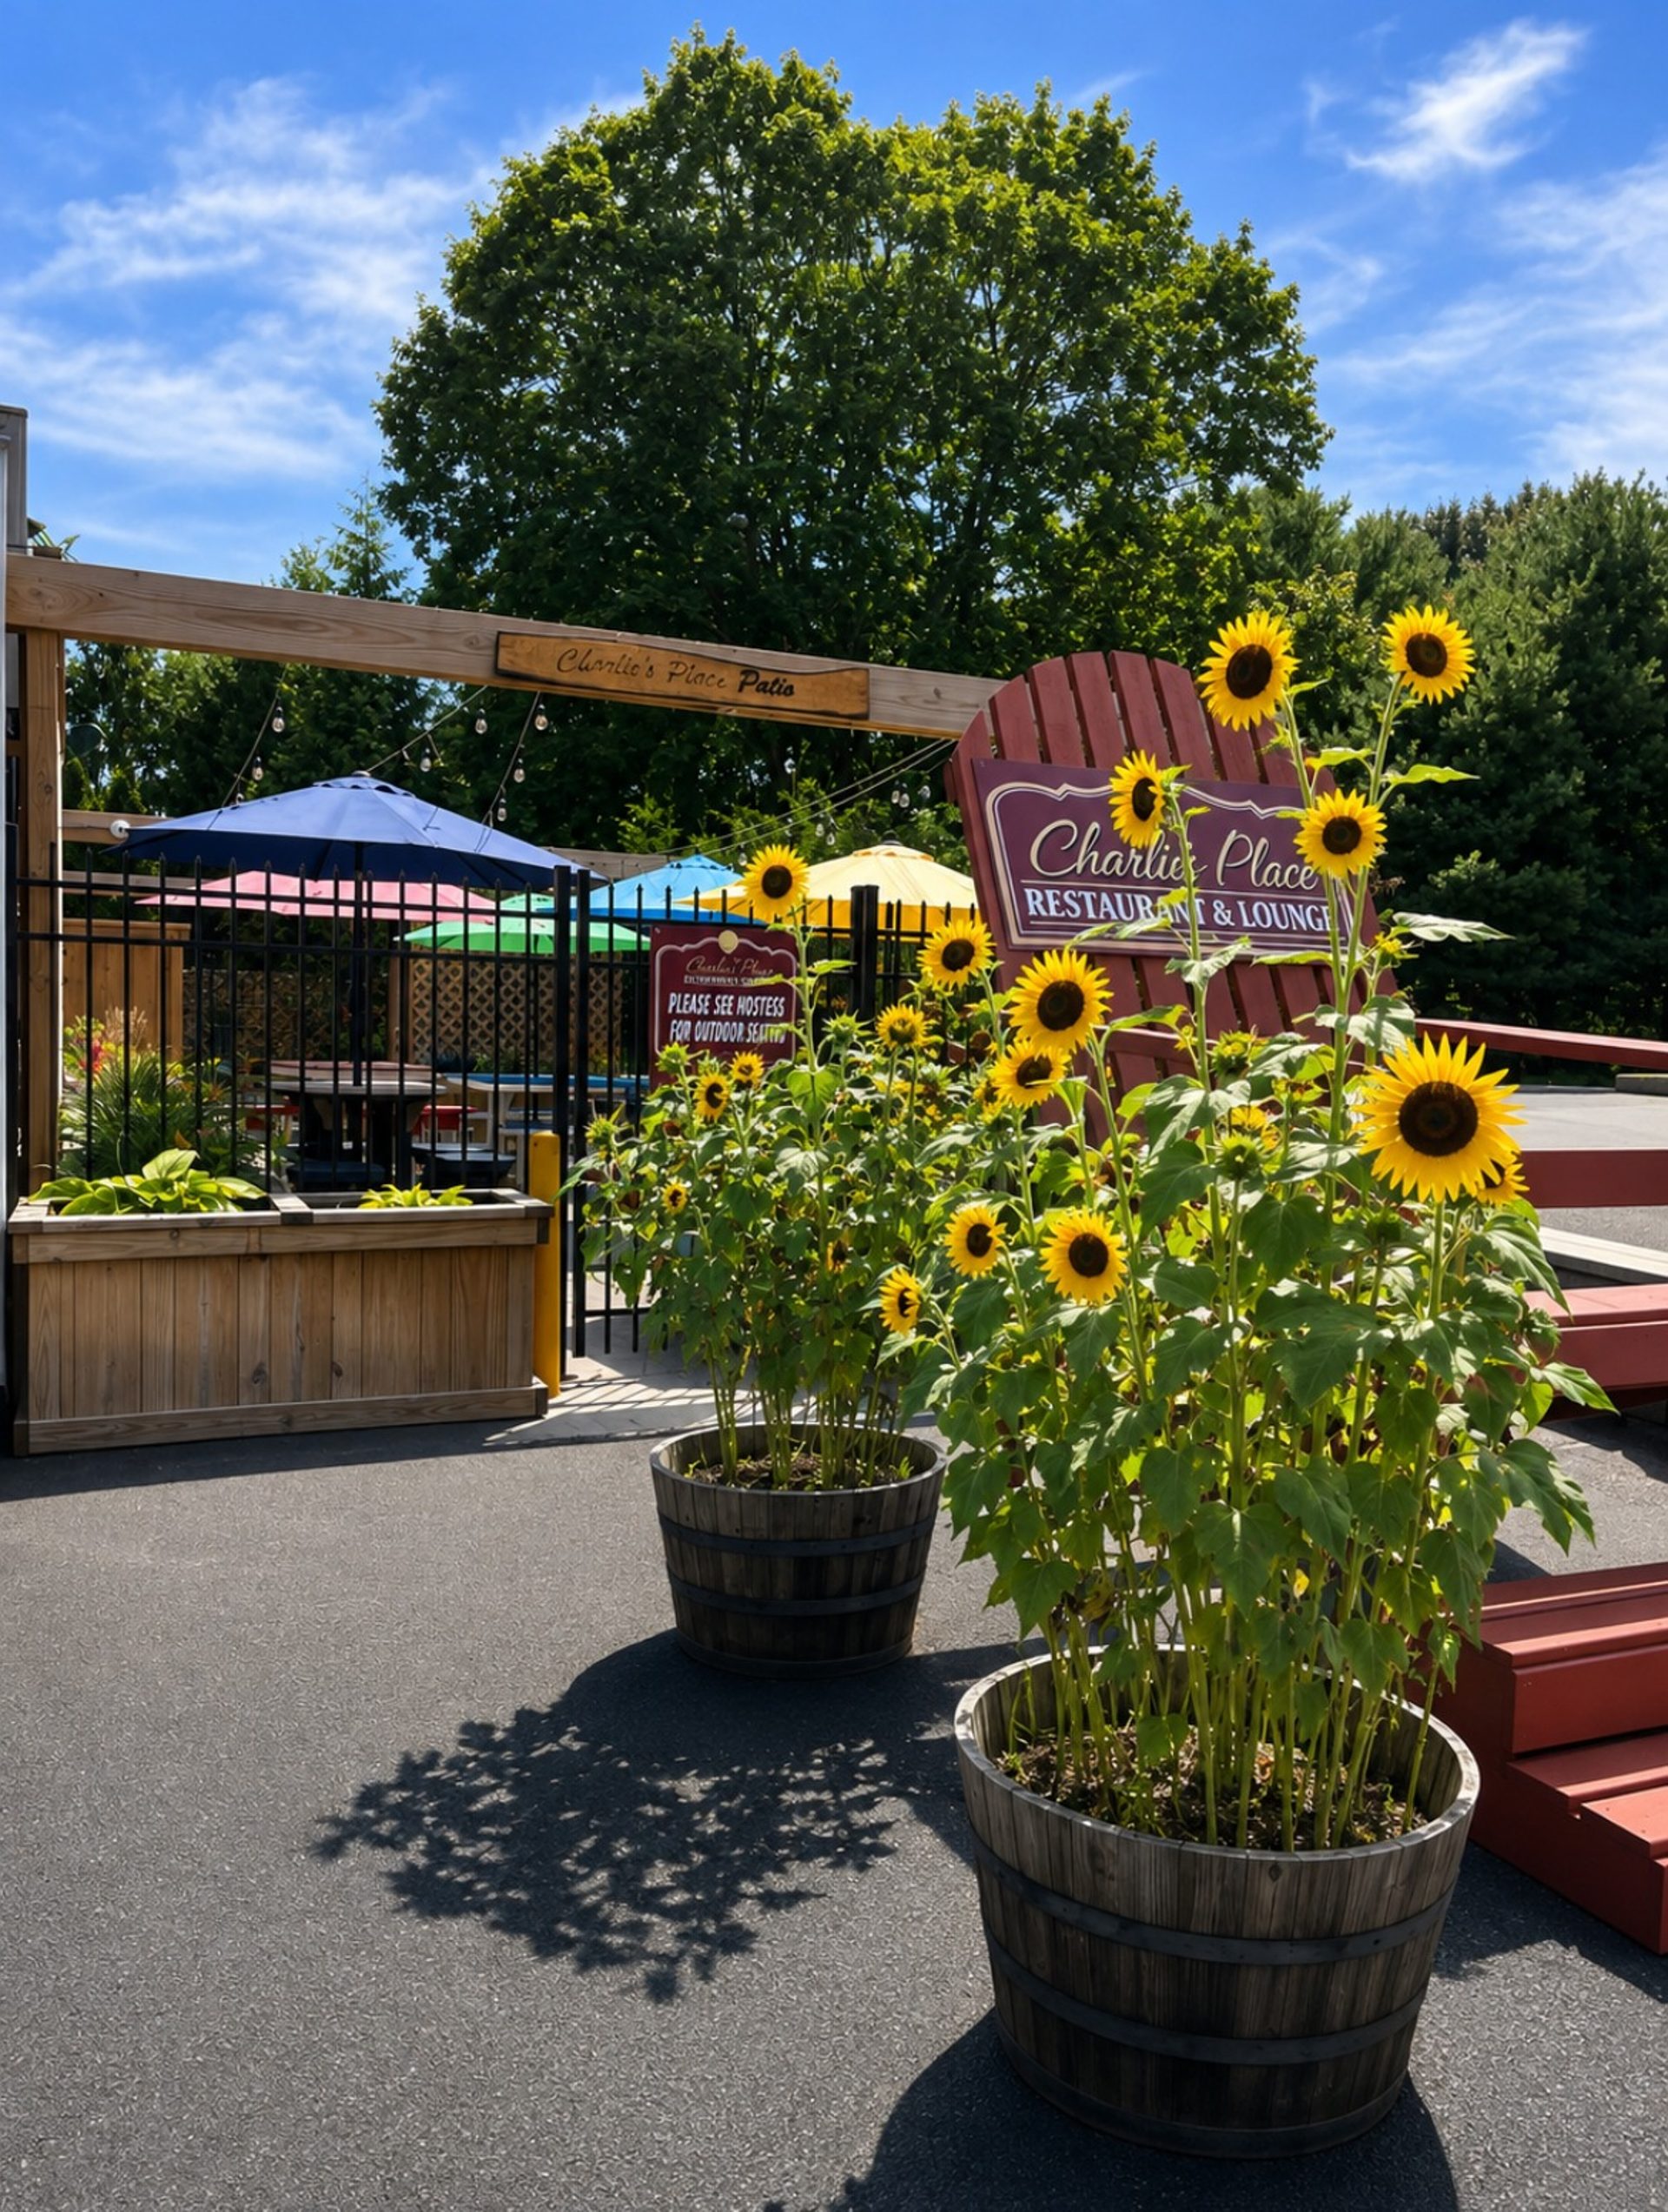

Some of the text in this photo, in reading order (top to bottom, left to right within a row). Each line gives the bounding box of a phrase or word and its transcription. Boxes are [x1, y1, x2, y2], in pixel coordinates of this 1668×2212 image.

[738, 668, 795, 697] Patio
[1216, 829, 1319, 891] Place
[1213, 900, 1235, 926] &
[667, 992, 785, 1017] PLEASE SEE HOSTESS
[669, 1019, 692, 1043] FOR
[694, 1020, 745, 1043] OUTDOOR
